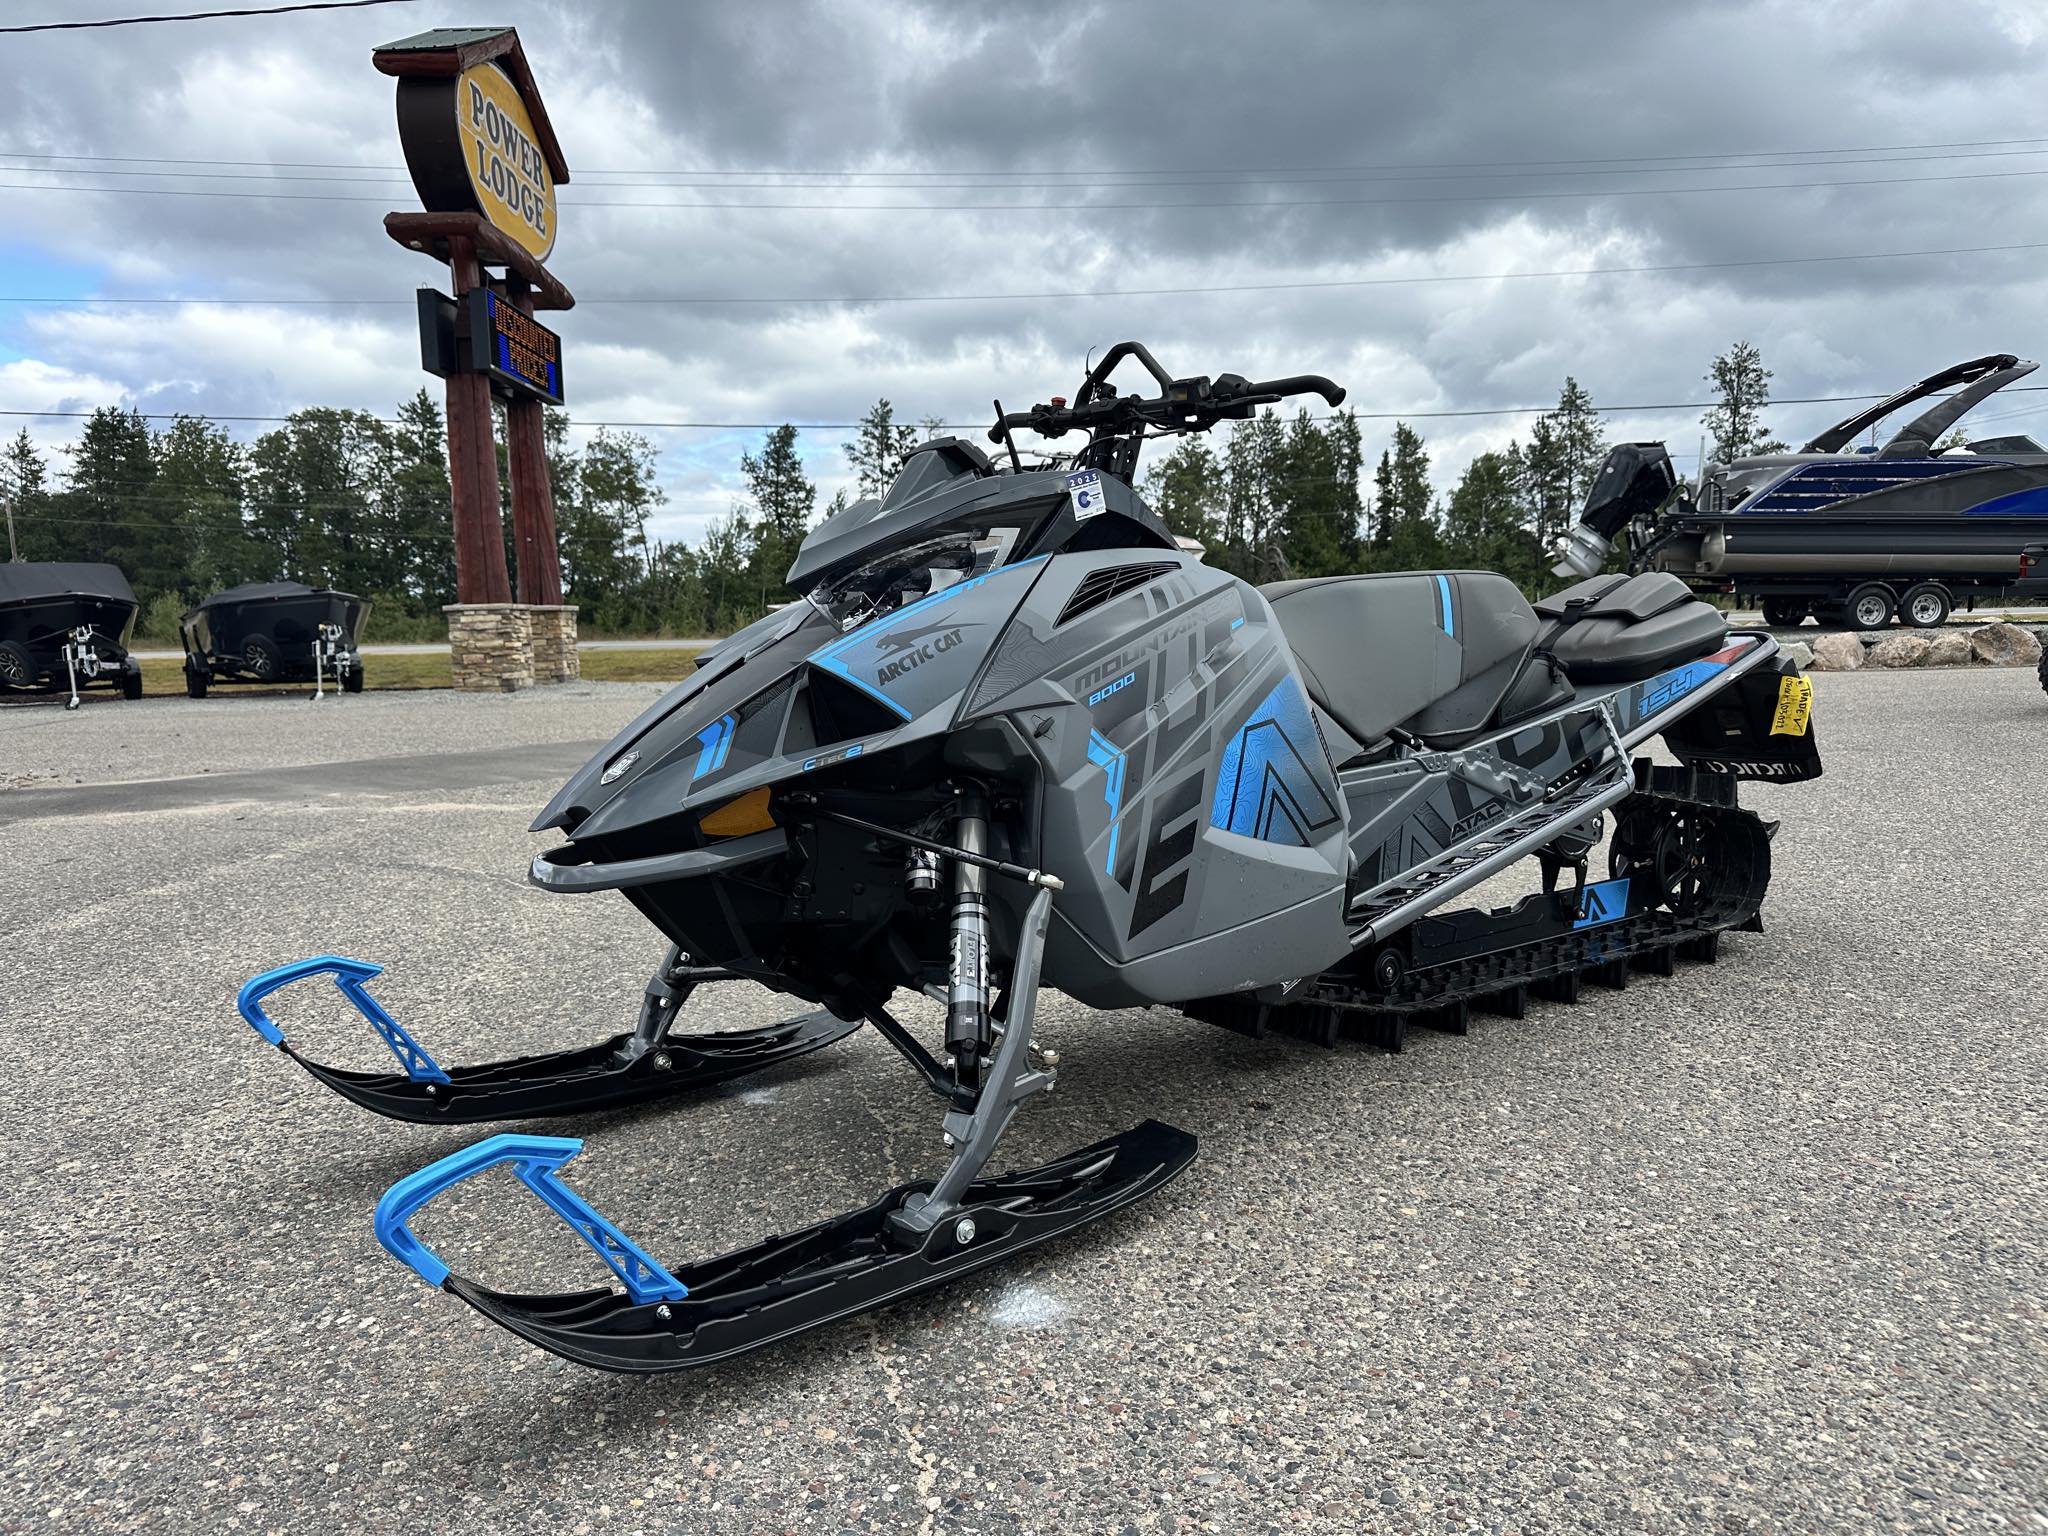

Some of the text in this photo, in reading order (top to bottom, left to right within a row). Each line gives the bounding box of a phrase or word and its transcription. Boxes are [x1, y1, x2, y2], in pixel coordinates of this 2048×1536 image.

[469, 80, 546, 193] POWER
[476, 139, 546, 236] LODGE
[1069, 472, 1097, 487] 2025
[877, 628, 963, 686] ARCTIC CAT
[1075, 611, 1201, 695] MOUNTAIN
[1088, 671, 1136, 707] 8000
[1638, 669, 1693, 719] 154
[1796, 682, 1812, 714] TRADE
[1450, 802, 1503, 839] ATAC
[949, 932, 962, 987] FOX
